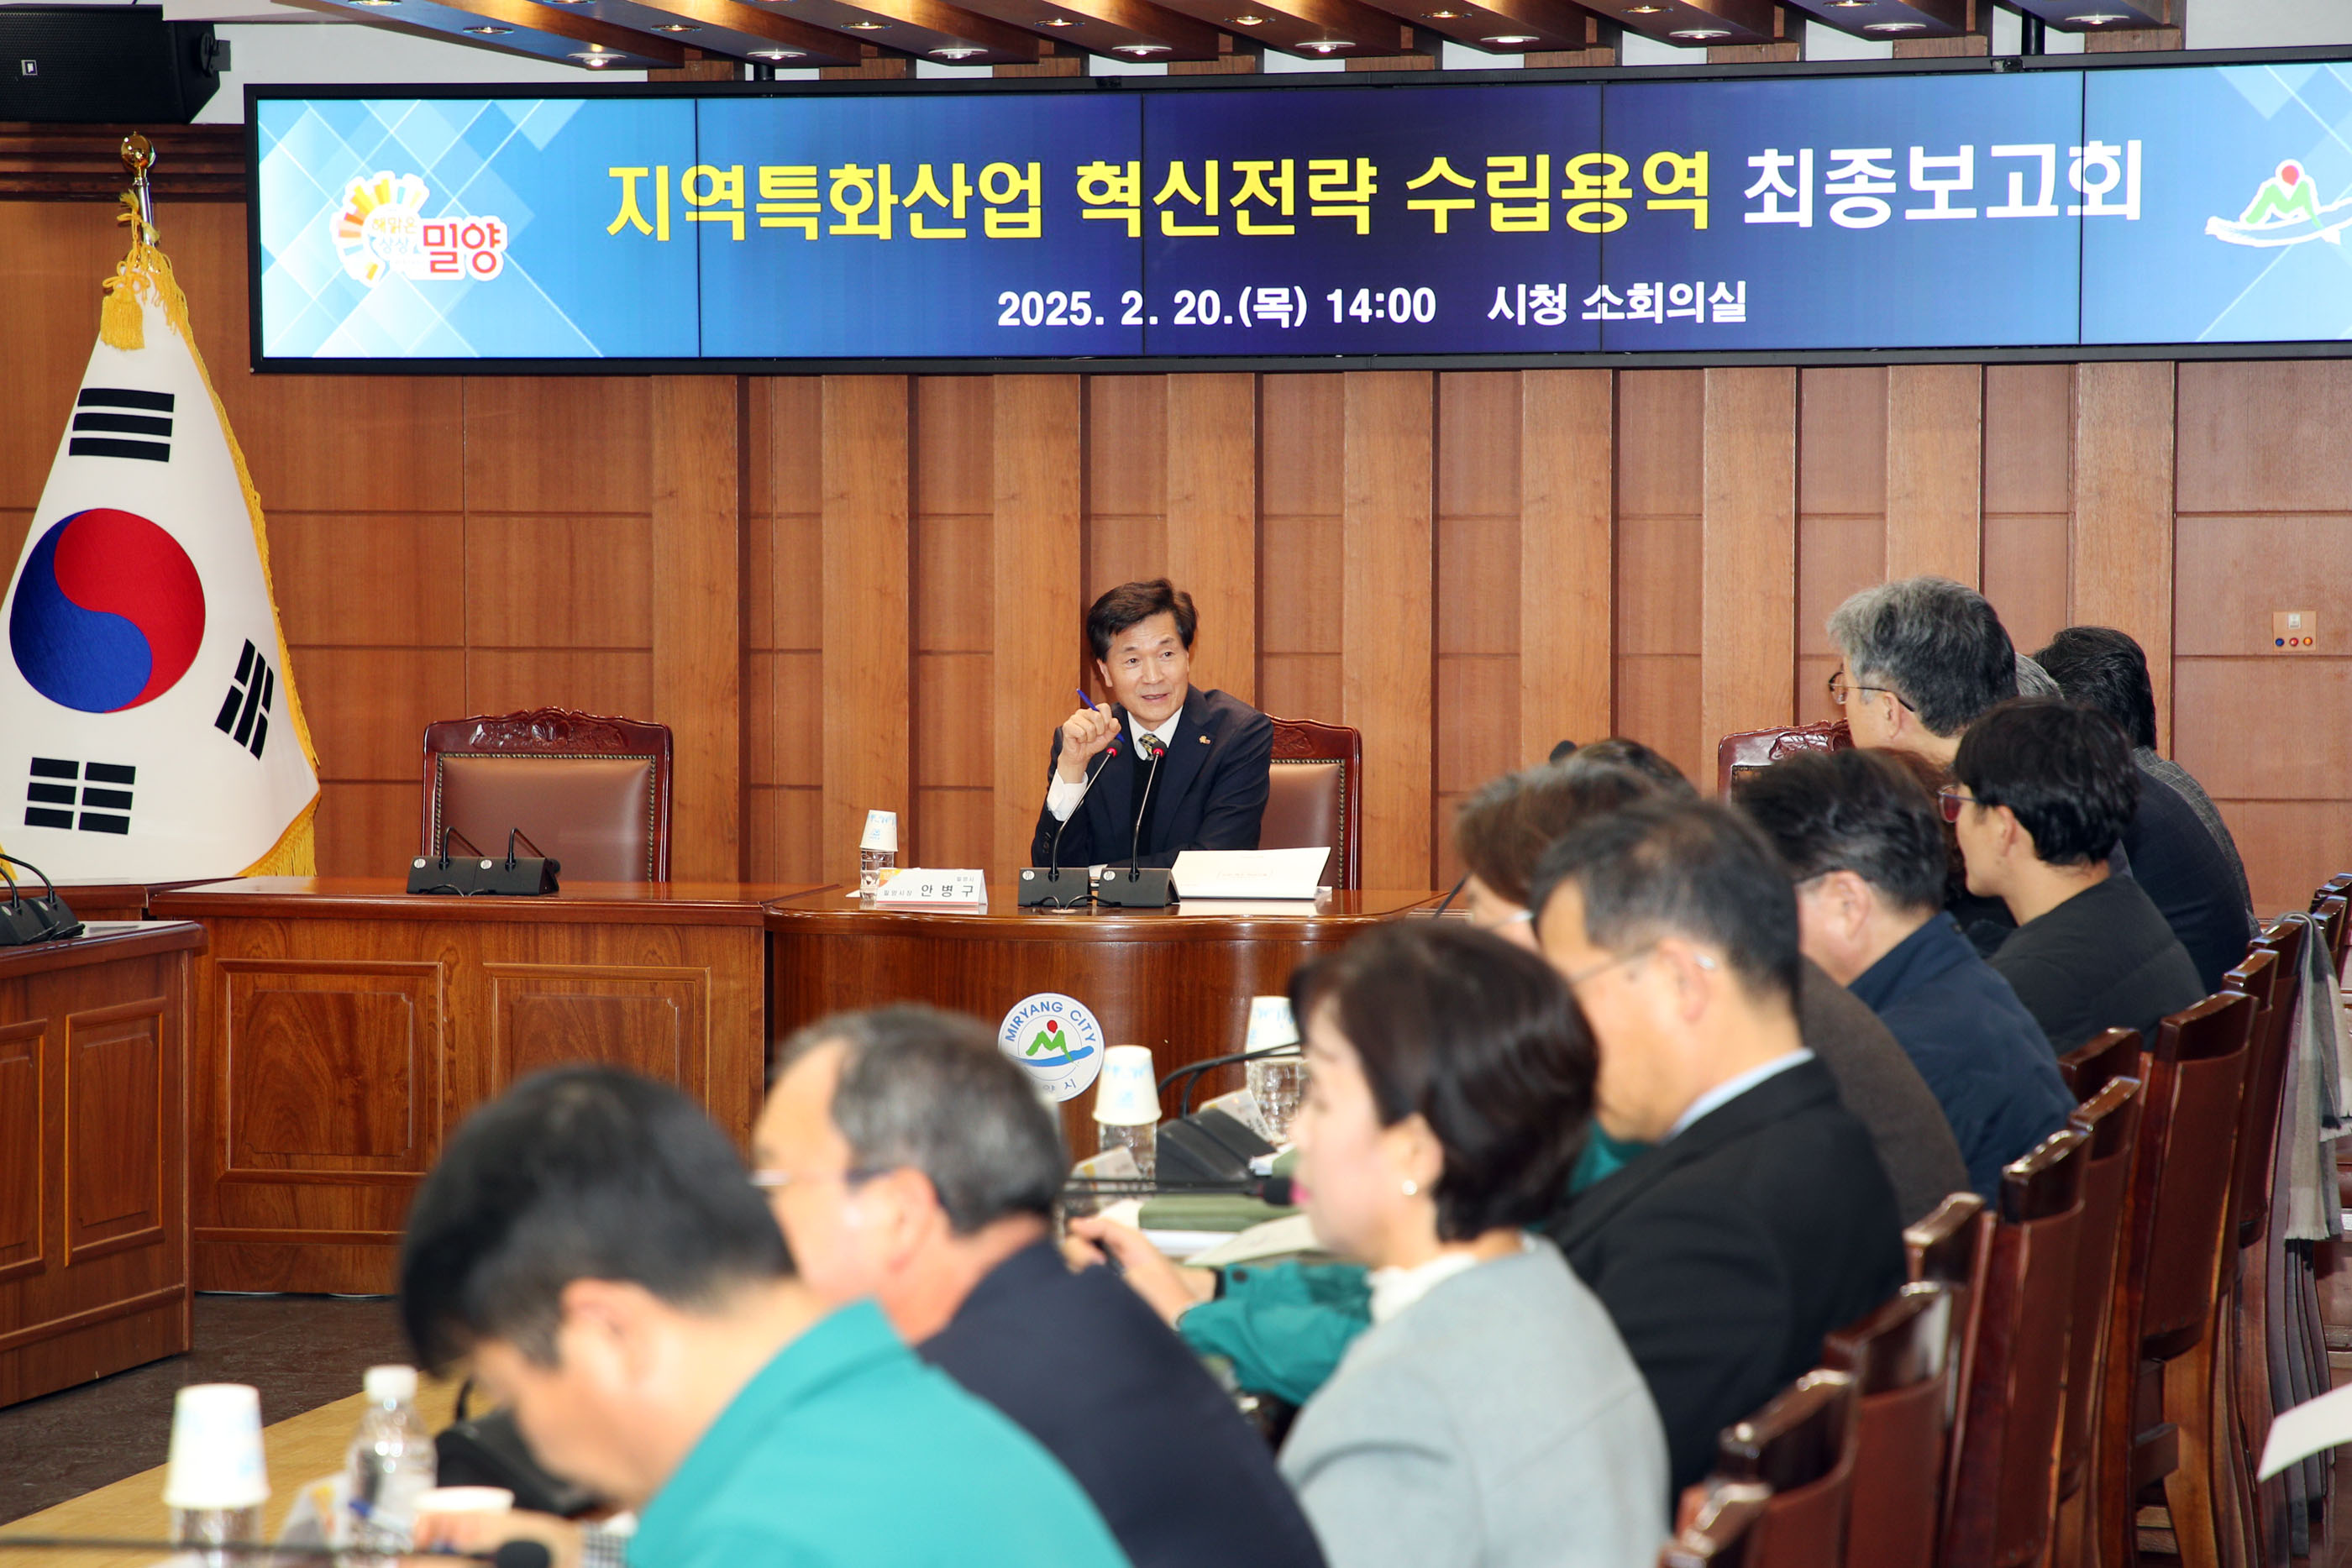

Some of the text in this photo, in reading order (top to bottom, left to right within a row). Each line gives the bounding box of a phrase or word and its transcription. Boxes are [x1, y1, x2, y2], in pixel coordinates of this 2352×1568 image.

[606, 139, 2142, 242] 지역특화산업 혁신전략 수립용역 최종보고회
[423, 223, 501, 274] 밀양
[997, 280, 1746, 328] 2025. 2. 20.(목) 14:00 시청 소회의실
[1005, 1001, 1096, 1042] MIRYANG CITY
